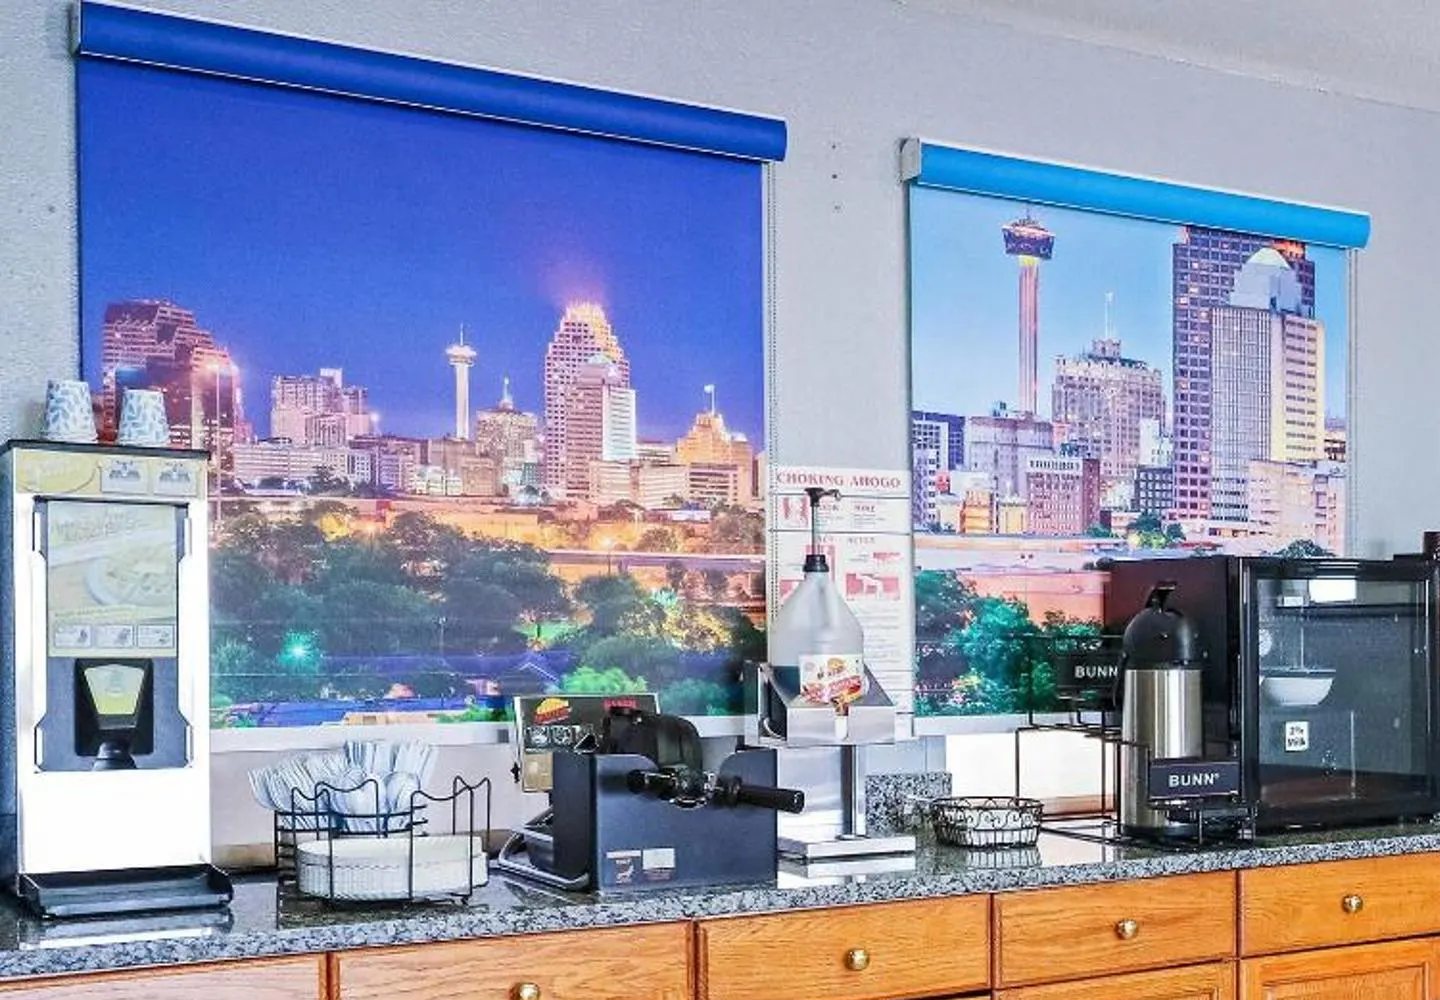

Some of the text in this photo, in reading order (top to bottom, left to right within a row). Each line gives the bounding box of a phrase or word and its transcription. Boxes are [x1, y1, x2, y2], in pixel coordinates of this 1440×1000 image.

[777, 472, 844, 486] CHOKING
[1074, 665, 1118, 679] BUNN
[1168, 773, 1214, 788] BUNN
